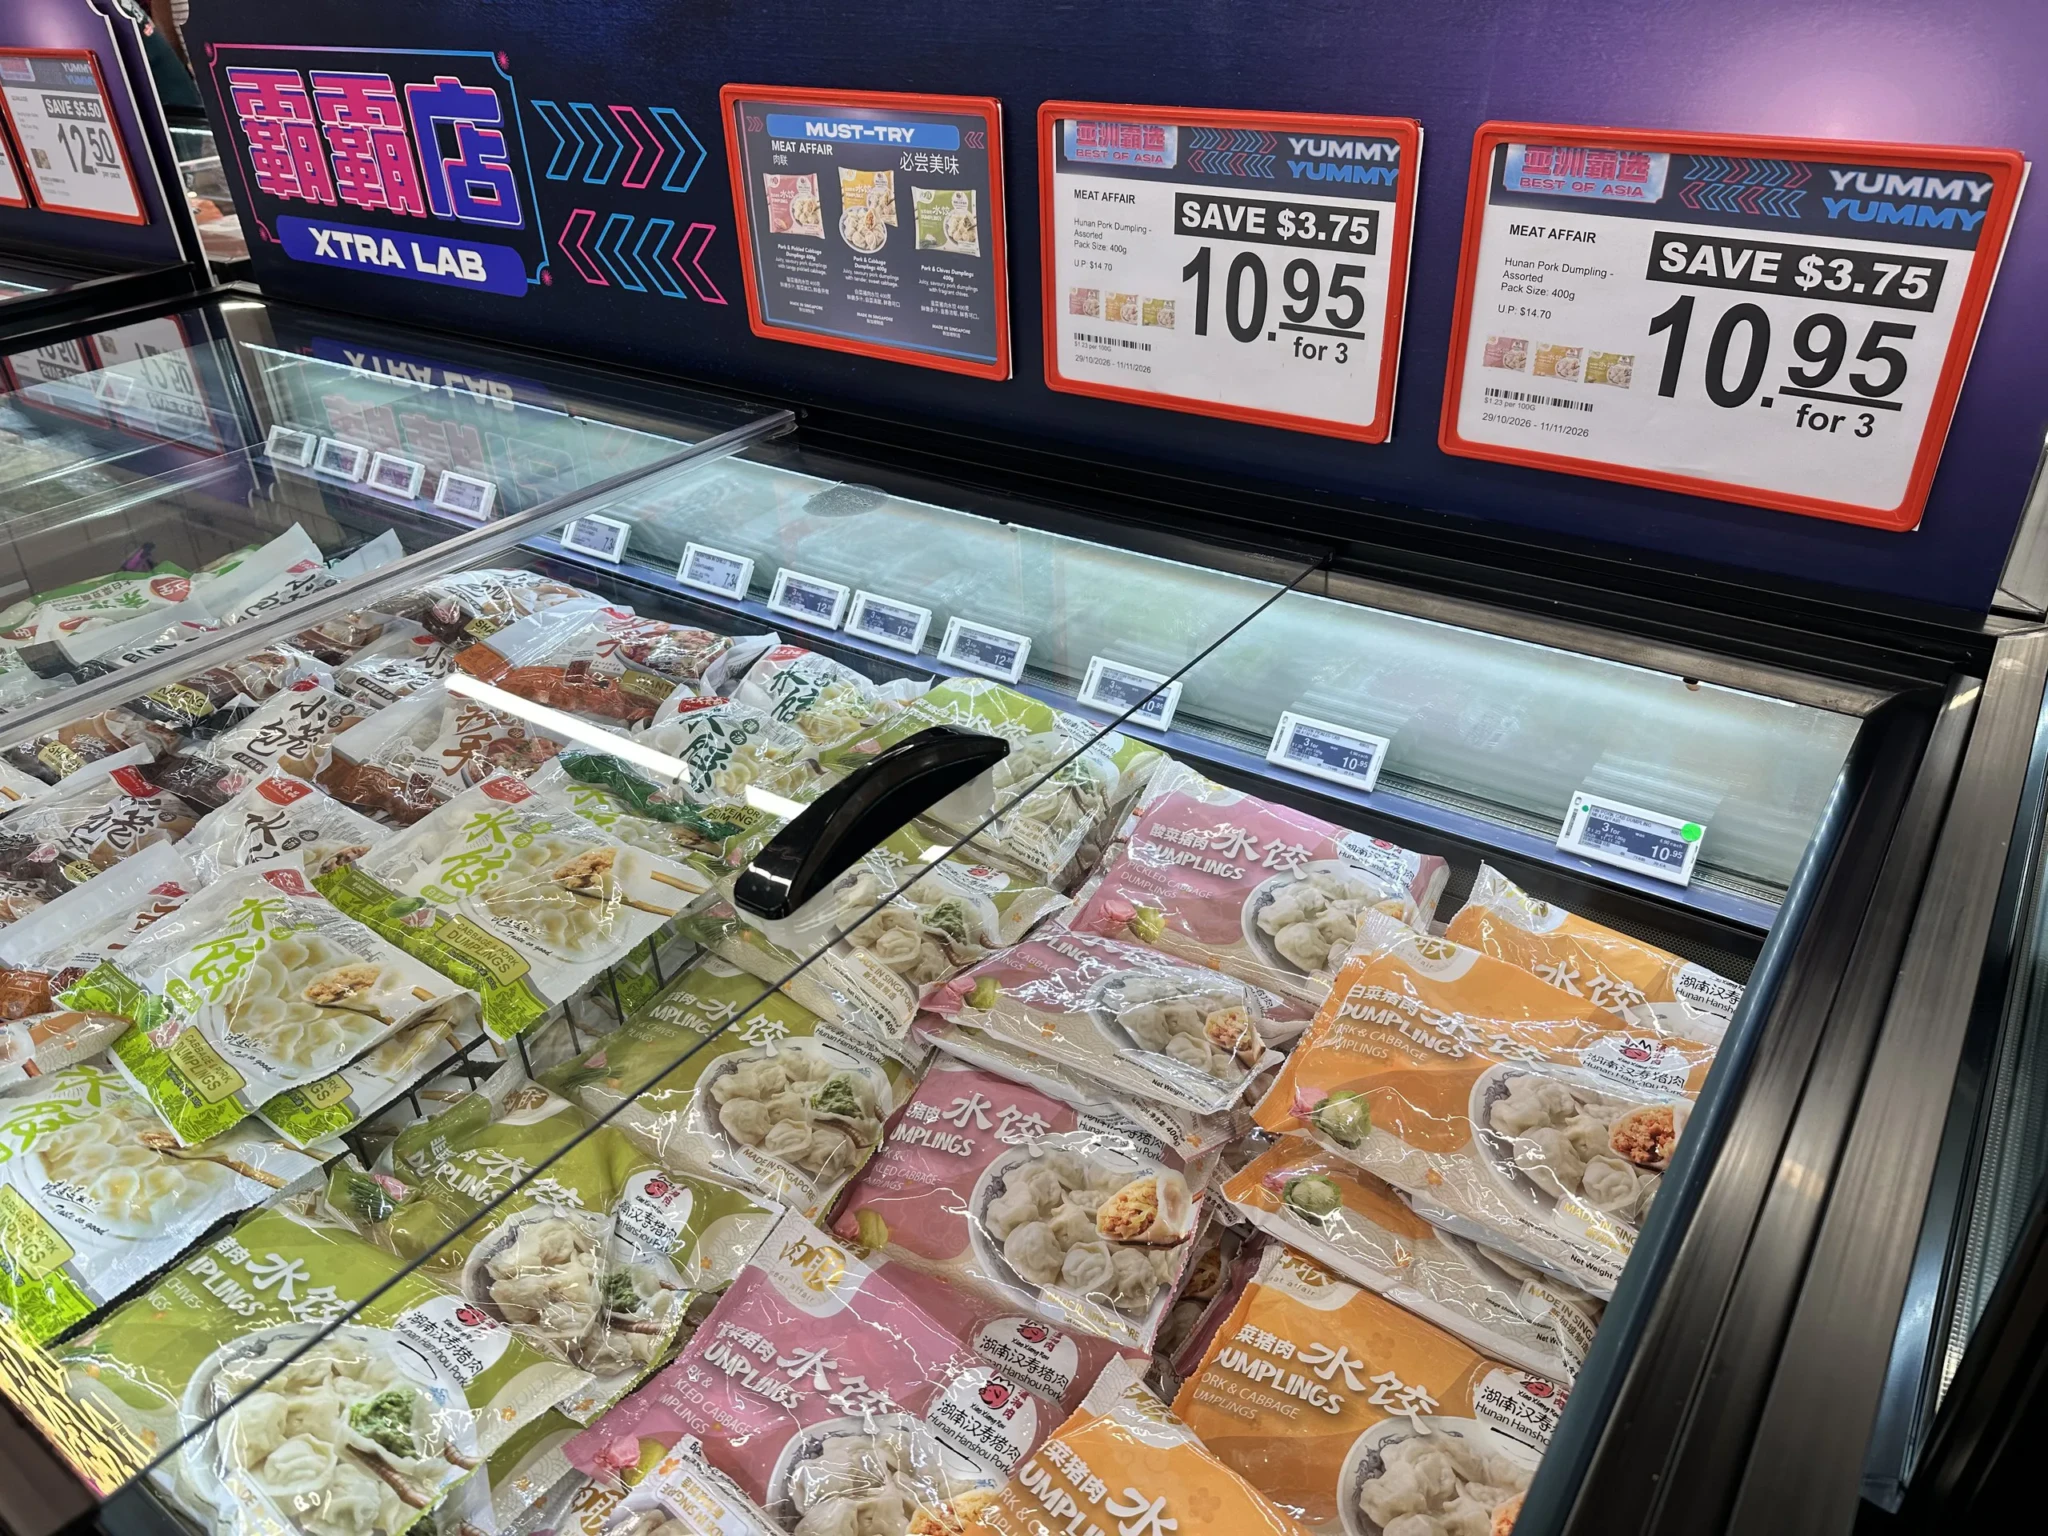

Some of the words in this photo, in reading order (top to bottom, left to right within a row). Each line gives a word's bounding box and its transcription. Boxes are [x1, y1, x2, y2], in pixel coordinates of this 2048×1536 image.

[47, 98, 74, 115] SAVE
[75, 103, 102, 118] $5.50
[805, 121, 915, 143] MUST-TRY
[57, 122, 116, 176] 12.50
[771, 140, 797, 153] MEAT
[799, 142, 833, 156] AFFAIR
[1076, 148, 1108, 159] BEST
[1113, 151, 1129, 161] OF
[1134, 153, 1163, 164] ASIA
[1288, 137, 1400, 162] YUMMY
[900, 151, 960, 176] 必尝美味
[1286, 160, 1398, 186] YUMMY
[1074, 189, 1099, 201] MEAT
[1101, 191, 1136, 205] AFFAIR
[1519, 177, 1566, 191] BEST
[1571, 181, 1596, 193] OF
[1602, 185, 1645, 198] ASIA
[1828, 168, 1994, 202] YUMMY
[1074, 218, 1096, 229] Hunan
[1098, 220, 1113, 230] Pork
[1114, 222, 1147, 235] Dumpling
[1181, 200, 1266, 235] SAVE
[1276, 207, 1370, 246] $3.75
[1822, 196, 1988, 232] YUMMY
[1074, 229, 1103, 240] Assorted
[1074, 240, 1090, 250] Pack
[1110, 243, 1127, 255] 400g
[1509, 223, 1546, 238] MEAT
[1547, 228, 1597, 244] AFFAIR
[308, 226, 406, 270] XTRA
[411, 242, 487, 282] LAB
[1504, 257, 1535, 269] Hunan
[1537, 260, 1559, 272] Pork
[1561, 263, 1608, 279] Dumpling
[1502, 269, 1544, 283] Assorted
[1658, 241, 1784, 285] SAVE
[1794, 253, 1933, 302] $3.75
[1181, 246, 1366, 343] 10.95
[1500, 282, 1524, 294] Pack
[1525, 285, 1549, 296] Size:
[1551, 289, 1575, 301] 400g
[1519, 306, 1552, 319] $14.70
[1075, 354, 1111, 368] 29/10/2026
[1117, 361, 1152, 374] 11/11/2026
[1294, 337, 1328, 361] for
[1334, 342, 1349, 364] 3
[1646, 294, 1917, 409] 10.95
[1484, 396, 1503, 406] $1.23
[1504, 401, 1516, 410] per
[1517, 402, 1536, 411] 100G
[1482, 412, 1532, 428] 29/10/2026
[1540, 421, 1590, 438] 11/11/2026
[1794, 402, 1847, 435] for
[1853, 411, 1877, 440] 3
[1303, 737, 1311, 747] 3
[1342, 756, 1369, 771] 10.95
[1601, 822, 1610, 832] 3
[1610, 827, 1620, 836] for
[1143, 840, 1247, 881] DUMPLINGS
[1209, 824, 1315, 881] 水饺
[1651, 844, 1683, 861] 10.95
[1120, 870, 1179, 899] DUMPLINGS
[1128, 860, 1168, 884] PICKLED
[1167, 878, 1214, 900] CABBAGE
[446, 928, 511, 974] DUMPLINGS
[457, 922, 493, 947] CABBAGE
[499, 947, 519, 967] PORK
[884, 973, 915, 1014] SINGAPORE
[1534, 960, 1646, 1028] 水饺
[1674, 986, 1706, 1004] Hunan
[646, 1024, 679, 1039] CHIVES
[1339, 1001, 1466, 1060] DUMPLINGS
[185, 1033, 214, 1068] CABBAGE
[213, 1063, 234, 1085] PORK
[865, 1052, 884, 1066] Pork
[1369, 1030, 1430, 1062] CABBAGE
[1163, 1083, 1187, 1098] Weight
[941, 1092, 1052, 1159] 水饺
[1165, 1125, 1182, 1148] 400g
[888, 1122, 977, 1158] UMPLINGS
[1141, 1146, 1162, 1163] Pork
[743, 1148, 765, 1167] MADE
[775, 1164, 817, 1203] SINGAPORE
[896, 1163, 938, 1186] CABBAGE
[36, 1229, 60, 1255] PORK
[83, 1222, 110, 1236] good
[1570, 1253, 1585, 1266] Net
[1584, 1260, 1614, 1280] Weight
[165, 1276, 204, 1310] CHIVES
[1527, 1283, 1561, 1310] MADE
[1560, 1301, 1575, 1317] IN
[1535, 1332, 1550, 1344] Net
[420, 1337, 453, 1369] Hanshou
[449, 1362, 469, 1388] Pork
[703, 1340, 806, 1410] UMPLINGS
[979, 1335, 1069, 1391] 湖南汉寿猪肉
[1002, 1364, 1042, 1392] Hanshou
[1041, 1384, 1064, 1402] Pork
[1232, 1323, 1298, 1361] 菜猪肉
[1297, 1341, 1441, 1436] 水饺
[1191, 1387, 1259, 1420] UMPLINGS
[1201, 1371, 1226, 1392] ORK
[1239, 1387, 1301, 1421] CABBAGE
[1480, 1385, 1554, 1433] 湖南汉寿
[659, 1393, 711, 1435] MPLINGS
[701, 1400, 753, 1438] CABBAGE
[1474, 1401, 1510, 1427] Hunan
[927, 1411, 956, 1438] Hunan
[953, 1428, 992, 1463] Hanshou
[989, 1453, 1012, 1476] Pork
[937, 1399, 1022, 1465] 湖南汉寿猪肉
